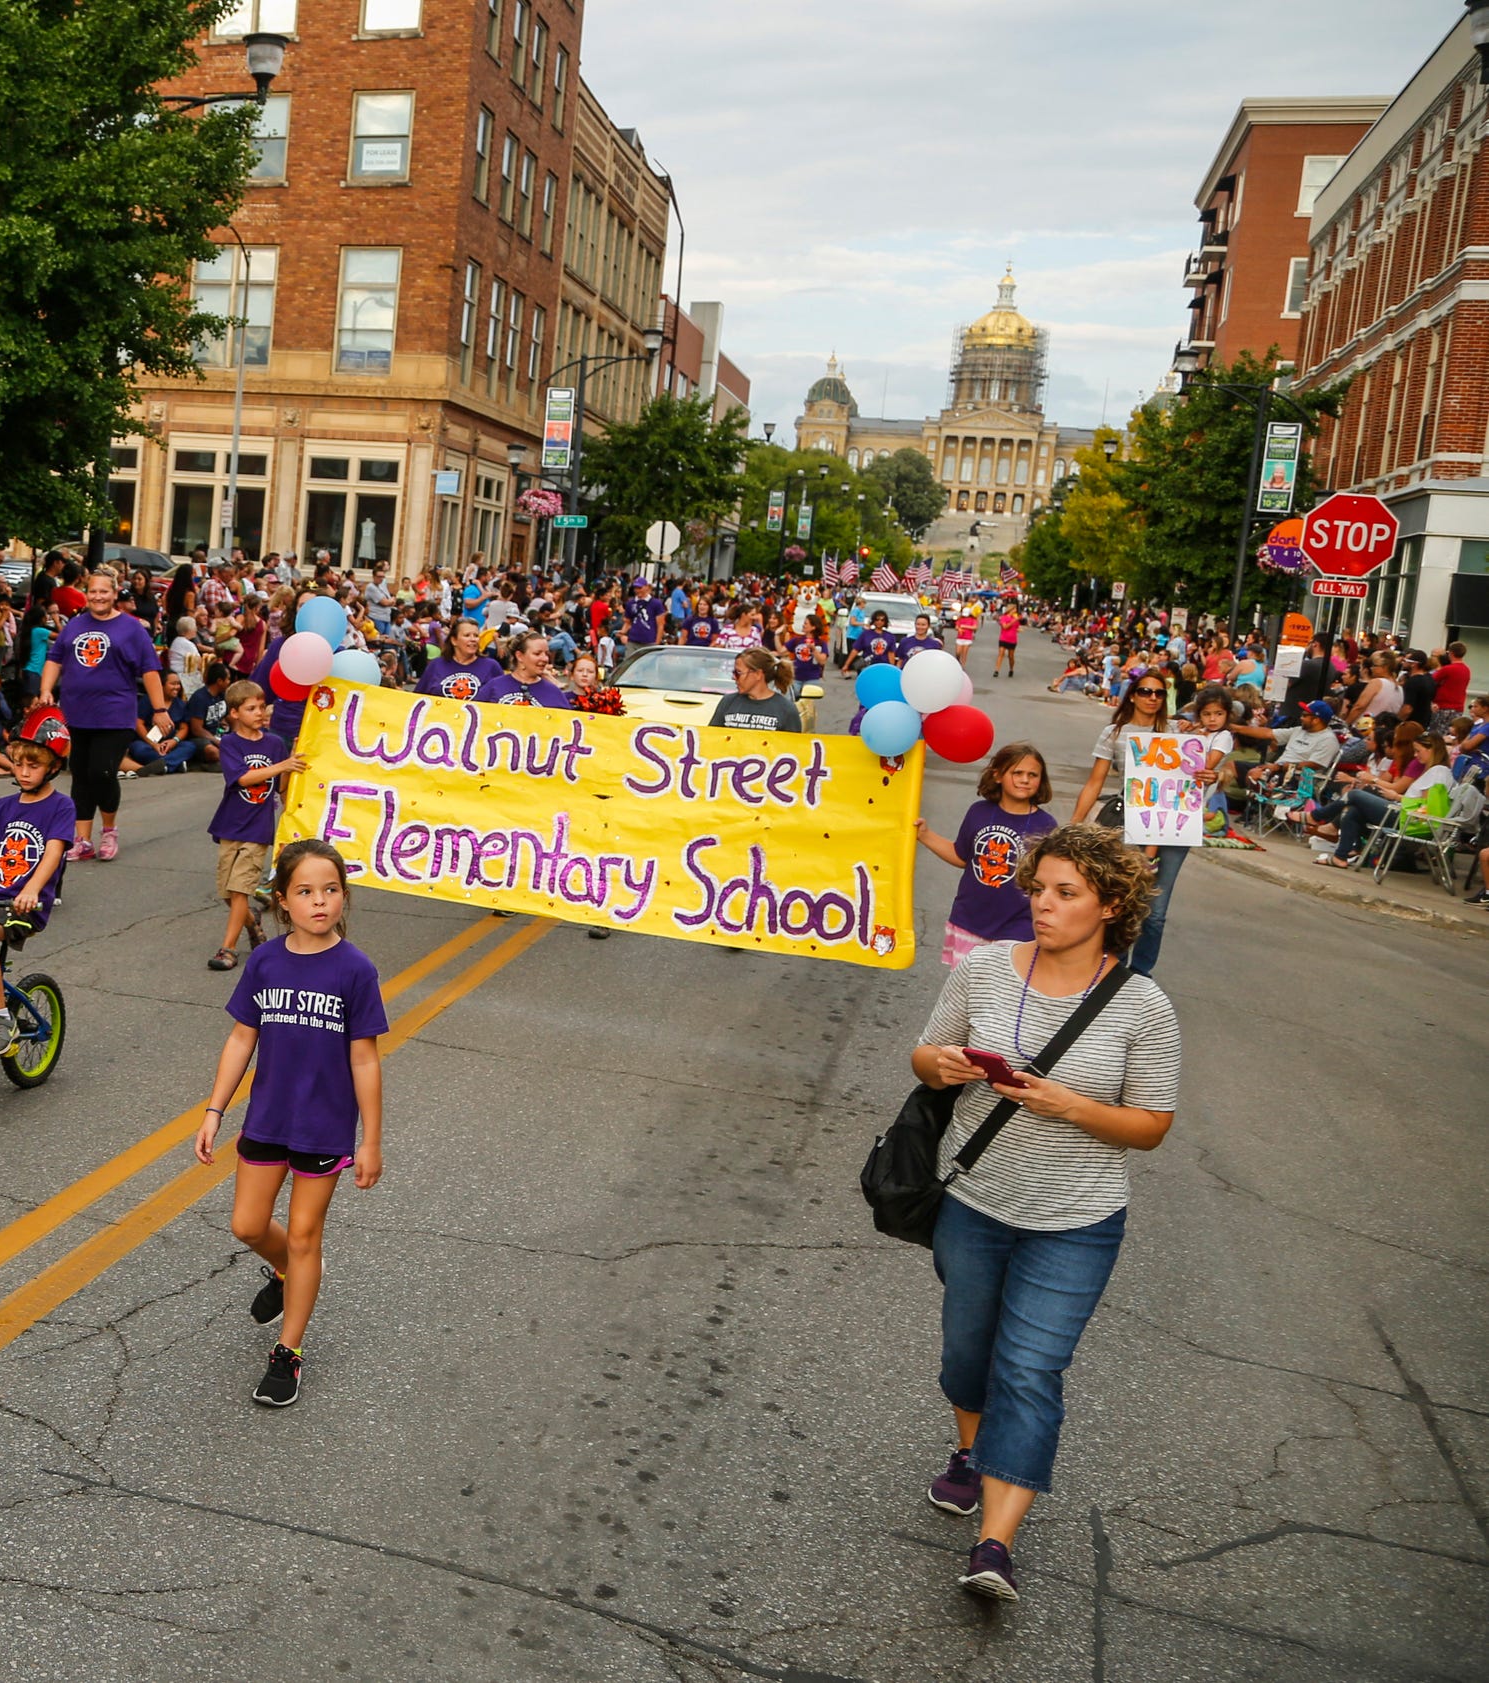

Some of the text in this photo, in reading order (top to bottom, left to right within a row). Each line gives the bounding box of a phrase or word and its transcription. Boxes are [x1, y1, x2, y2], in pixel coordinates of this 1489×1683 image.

[1309, 518, 1391, 553] STOP
[1283, 549, 1289, 557] 4
[1316, 583, 1363, 595] ALL WAY
[344, 691, 830, 808] Walnut Street
[1129, 736, 1206, 776] WSS
[1126, 777, 1203, 812] ROCKS
[7, 821, 33, 831] STREET
[991, 825, 1016, 837] STREET
[321, 781, 875, 946] Elementary School
[296, 990, 344, 1019] STREE
[274, 1012, 298, 1024] street
[299, 1014, 308, 1025] in
[310, 1016, 323, 1028] the
